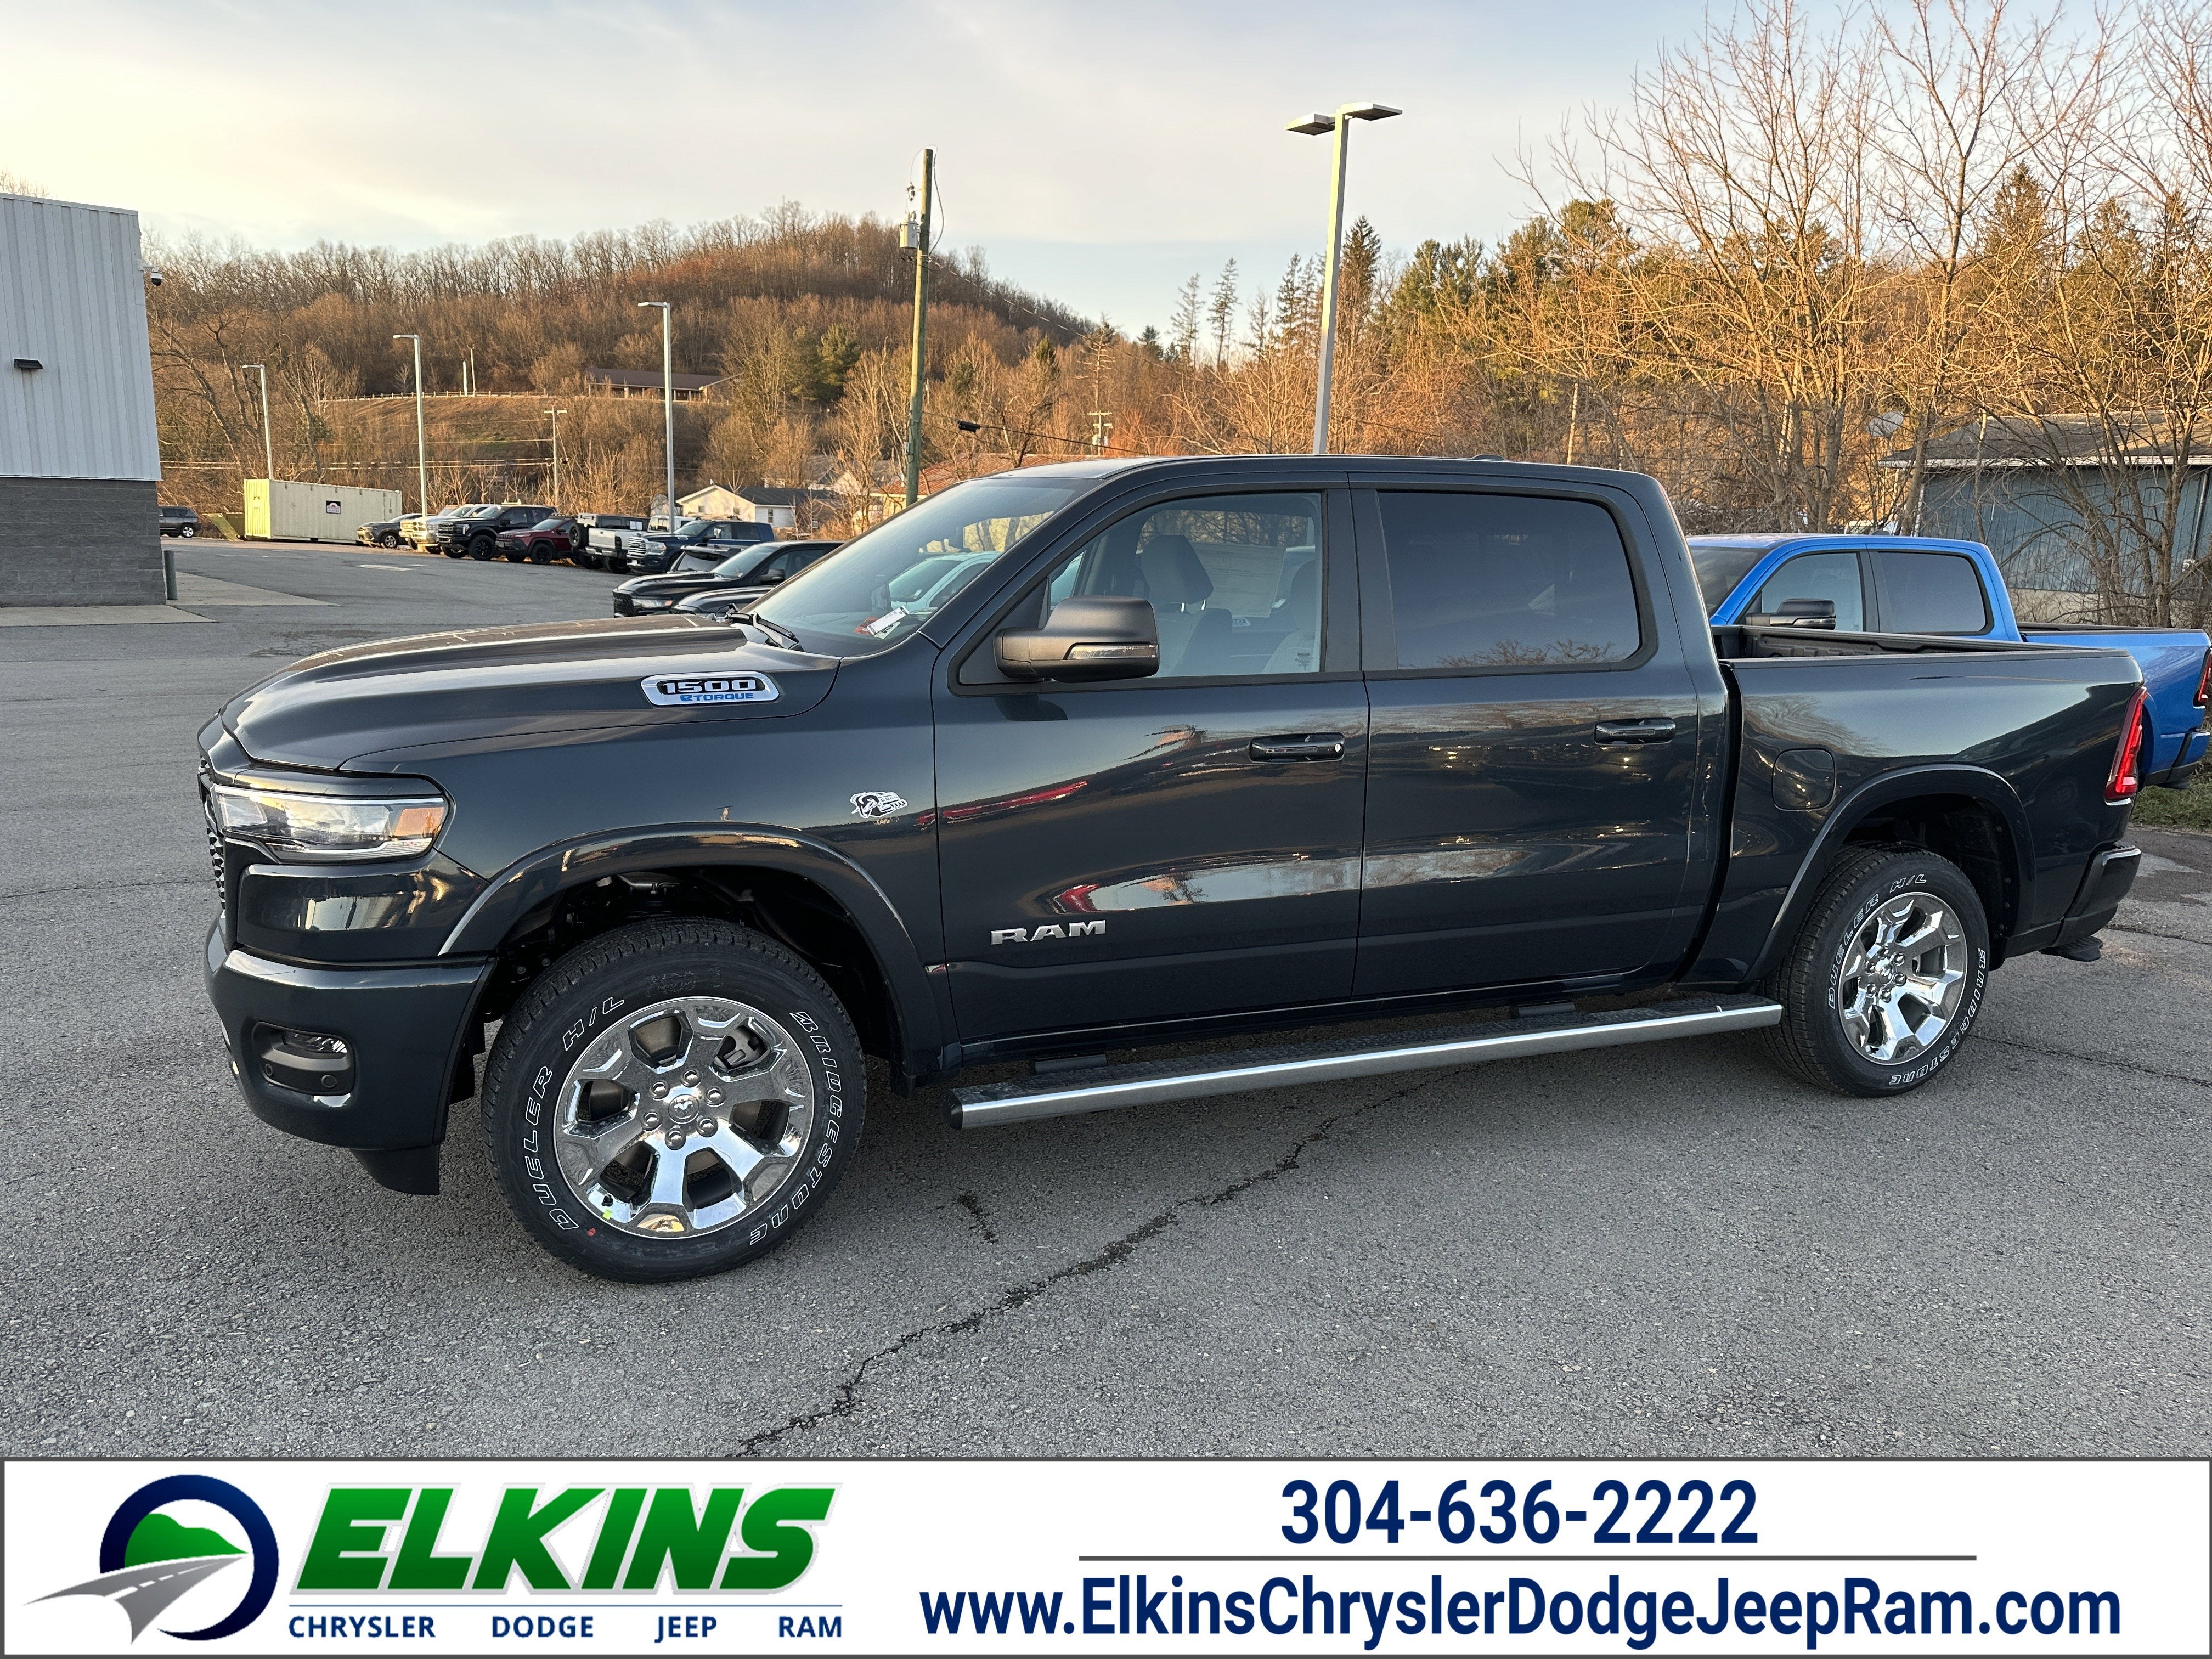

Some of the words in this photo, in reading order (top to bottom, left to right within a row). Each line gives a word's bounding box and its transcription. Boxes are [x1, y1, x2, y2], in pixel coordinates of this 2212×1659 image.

[663, 680, 756, 693] 1500
[680, 693, 754, 702] eTORQUE
[991, 920, 1106, 945] RAM
[1828, 894, 1879, 1009] DUELER
[1890, 874, 1927, 893] H/L
[1889, 947, 1986, 1085] BRIDGESTONE
[523, 1066, 580, 1230] DUELER
[563, 996, 624, 1051] H/L
[750, 1011, 842, 1245] BRIDGESTONE
